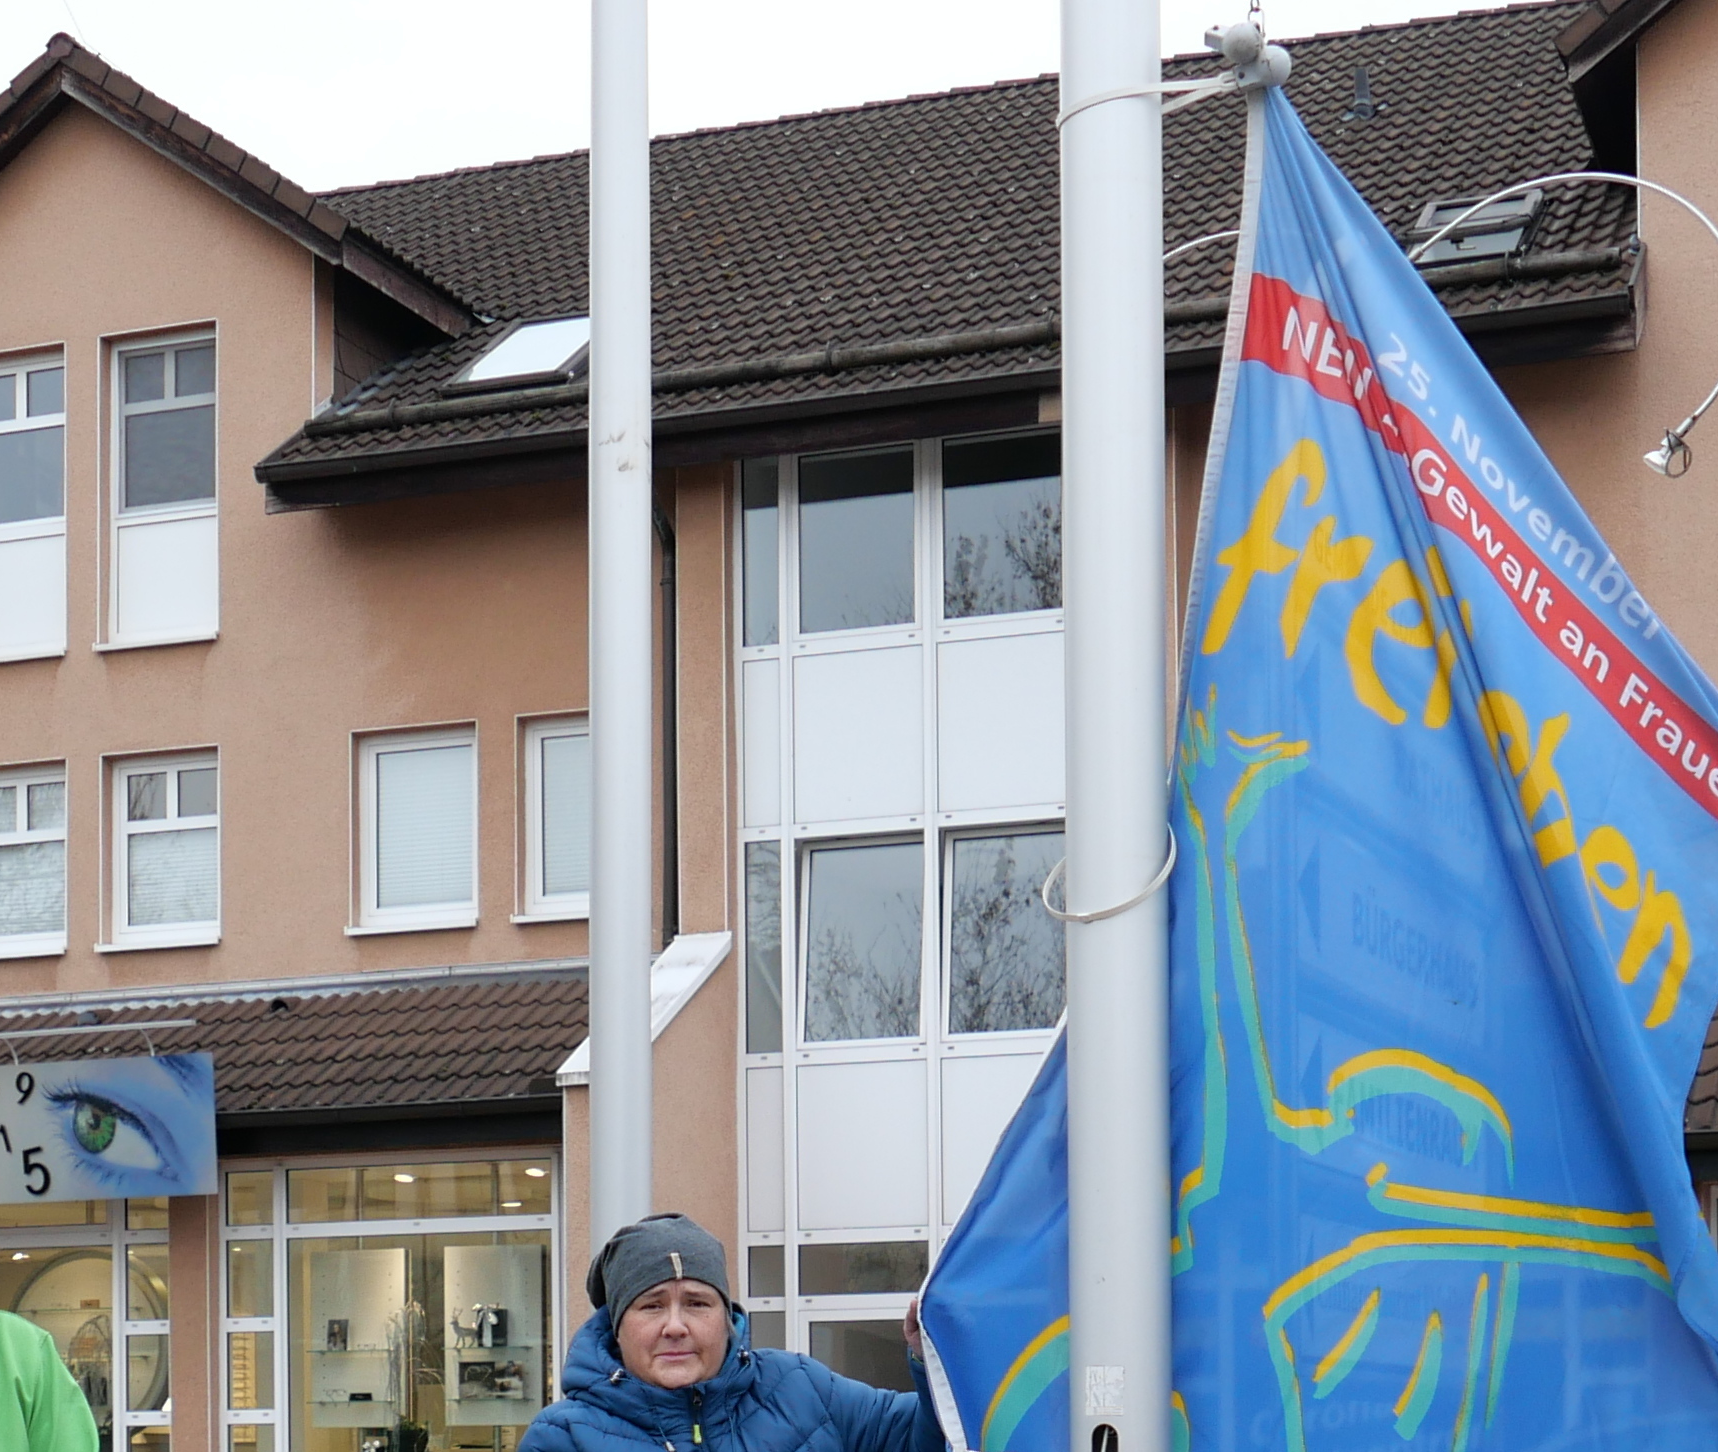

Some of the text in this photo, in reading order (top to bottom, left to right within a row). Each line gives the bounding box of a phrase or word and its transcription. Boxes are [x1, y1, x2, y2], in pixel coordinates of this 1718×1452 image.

[1201, 436, 1458, 729] frei
[1377, 332, 1438, 418] 25.
[1450, 414, 1661, 641] November
[1411, 448, 1554, 624] Gewalt
[1559, 619, 1611, 684] an
